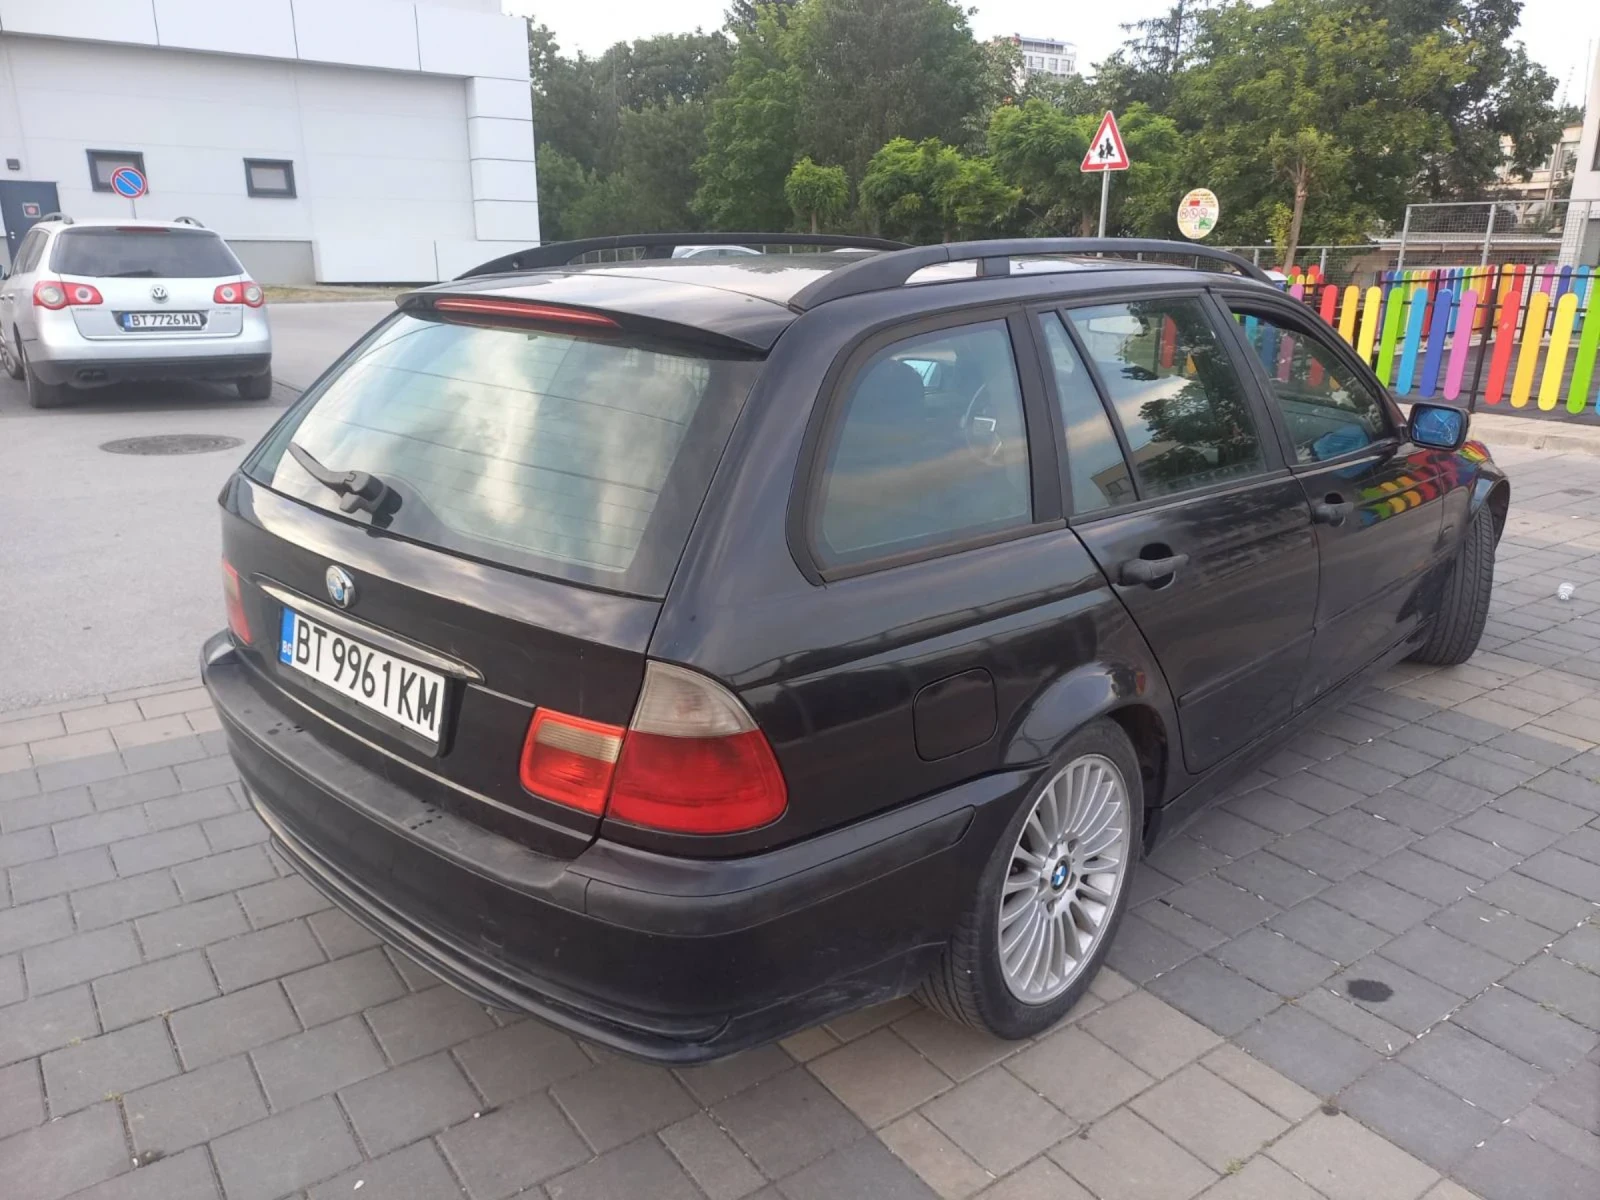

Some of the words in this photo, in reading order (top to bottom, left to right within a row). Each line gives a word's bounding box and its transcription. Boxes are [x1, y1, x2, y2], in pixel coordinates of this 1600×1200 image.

[132, 314, 148, 326] BT
[151, 314, 181, 326] 7726
[183, 314, 199, 325] MA
[282, 639, 293, 656] BG
[296, 619, 327, 672] BT
[332, 637, 392, 707] 9961
[397, 667, 439, 732] KM
